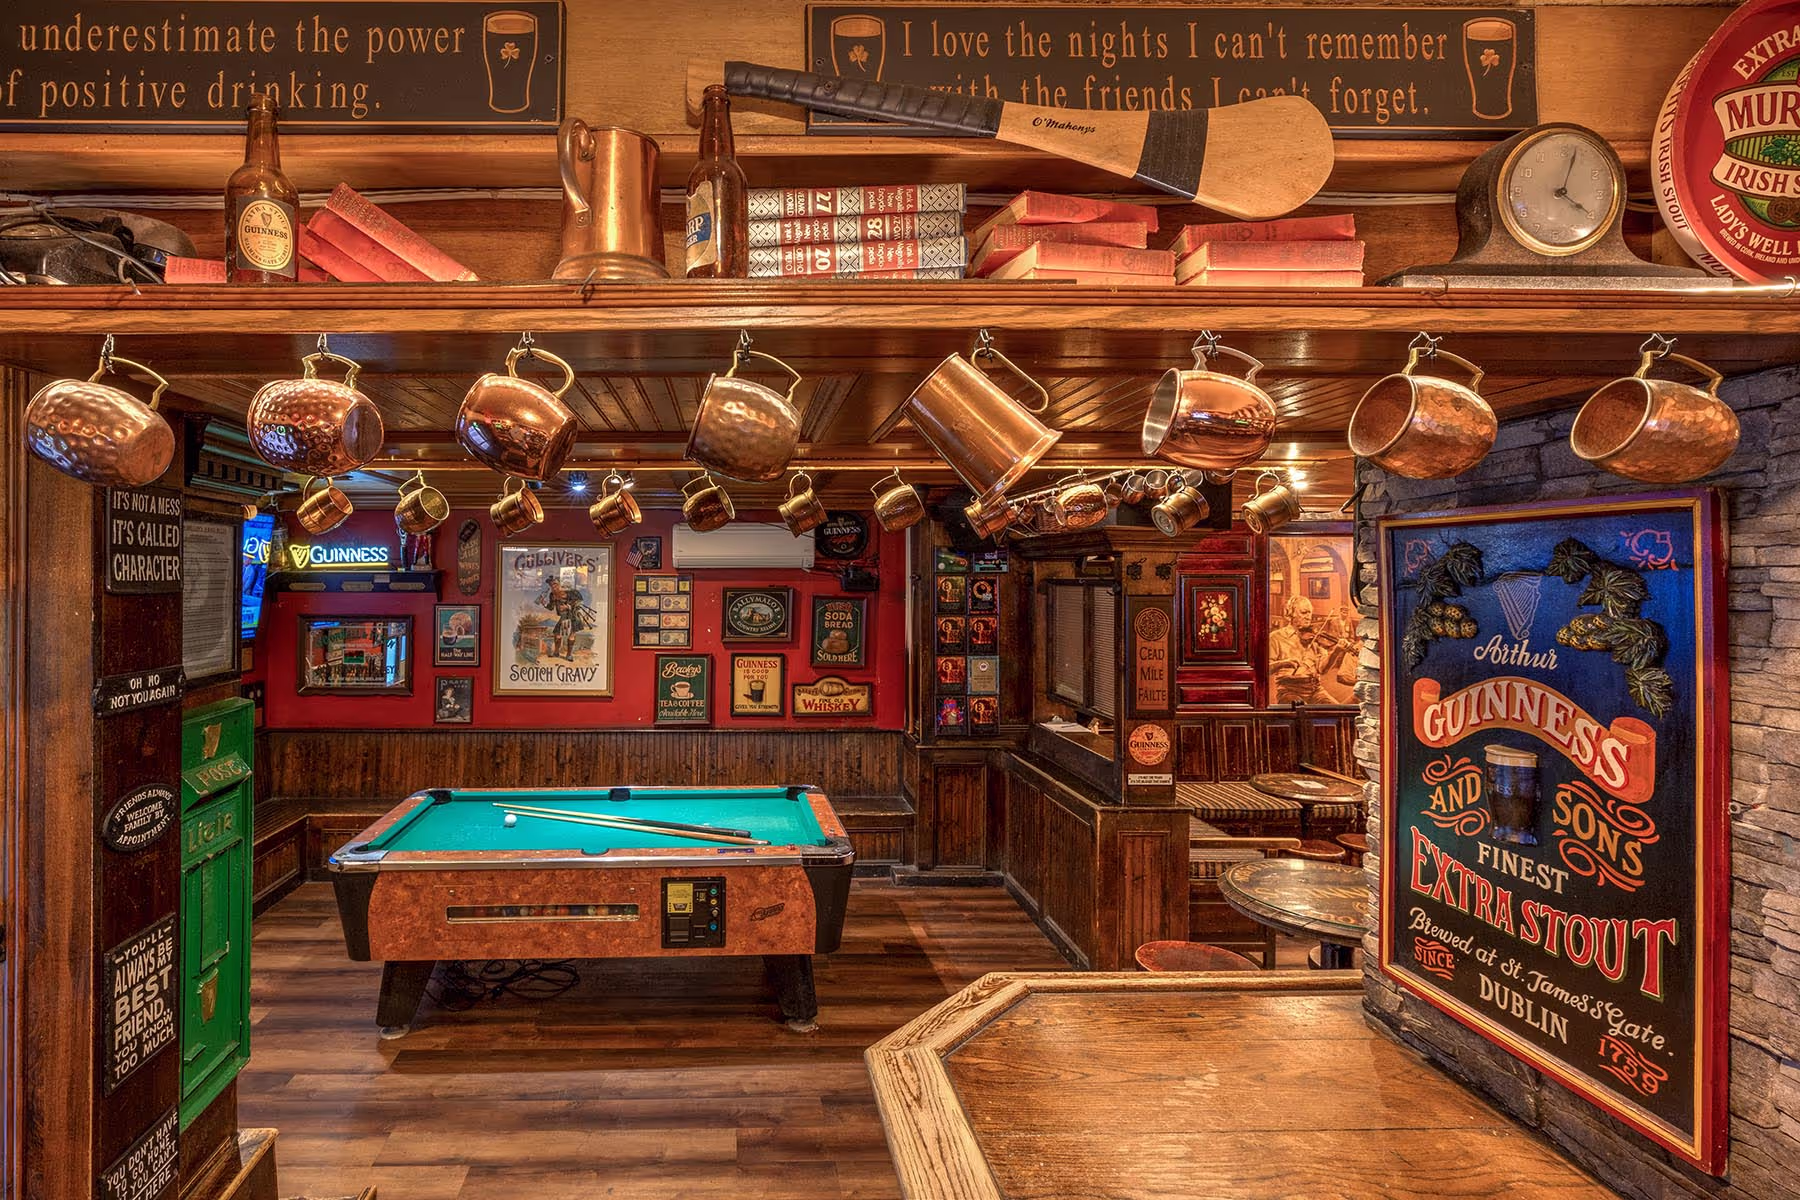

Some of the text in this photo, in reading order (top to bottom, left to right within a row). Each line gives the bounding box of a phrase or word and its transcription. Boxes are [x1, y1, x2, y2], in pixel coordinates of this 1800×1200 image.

[20, 13, 466, 64] underestimate the power
[902, 19, 1448, 68] I love the nights I can't remember
[0, 69, 381, 119] f positive drinking.
[1020, 74, 1069, 109] the
[1084, 74, 1193, 111] friends
[1329, 76, 1429, 125] forget.
[1031, 116, 1096, 135] O'Mahonys
[1658, 137, 1689, 231] IRISH STOUT
[1723, 162, 1790, 194] IRISH
[816, 191, 832, 214] 27
[867, 191, 876, 210] pedia
[886, 192, 894, 207] New
[244, 225, 288, 240] GUINNESS
[867, 217, 882, 240] 28
[1710, 194, 1793, 255] LADY'S WELL
[815, 247, 831, 271] 20
[867, 246, 876, 265] pedia
[886, 247, 894, 262] New
[113, 491, 180, 516] IT'S NOT A MESS
[113, 519, 180, 547] IT'S CALLED
[114, 553, 181, 581] CHARACTER
[310, 545, 388, 563] GUINNESS
[824, 621, 853, 629] BREAD
[825, 612, 852, 621] SODA
[736, 658, 778, 668] GUINNESS
[817, 649, 858, 662] SOLD HERE
[1473, 634, 1559, 670] Arthur
[130, 674, 160, 689] OH NO
[510, 664, 553, 682] SCOTCH
[110, 685, 175, 709] NOT YOU AGAIN
[802, 698, 860, 712] WHISKEY
[1130, 740, 1169, 748] GUINNESS
[1423, 681, 1630, 790] GUINNESS
[115, 789, 173, 821] FRIENDS ALWAYS
[126, 800, 163, 821] WELCOME
[116, 814, 171, 845] APPOINTMENT
[124, 808, 165, 833] FAMILY BY
[1428, 772, 1643, 876] AND SONS
[1477, 841, 1569, 894] FINEST
[1410, 826, 1678, 999] EXTRA STOUT
[157, 950, 173, 968] MY
[1408, 907, 1474, 954] Brewed
[1476, 945, 1499, 967] at
[1501, 958, 1525, 983] St.
[1414, 945, 1456, 969] SINCE
[114, 937, 173, 998] ALWAYS BE
[115, 964, 173, 1025] BEST
[1479, 973, 1569, 1045] DUBLIN
[114, 1011, 173, 1063] YOU KNOW
[114, 1023, 174, 1079] TOO MUCH
[1598, 1038, 1659, 1094] 1759
[107, 1111, 178, 1191] YOU DON'T HAVE
[115, 1178, 127, 1198] TO
[132, 1161, 144, 1179] GO
[147, 1133, 170, 1165] HOME
[130, 1140, 176, 1195] YOU CAN'T
[145, 1164, 171, 1200] HERE
